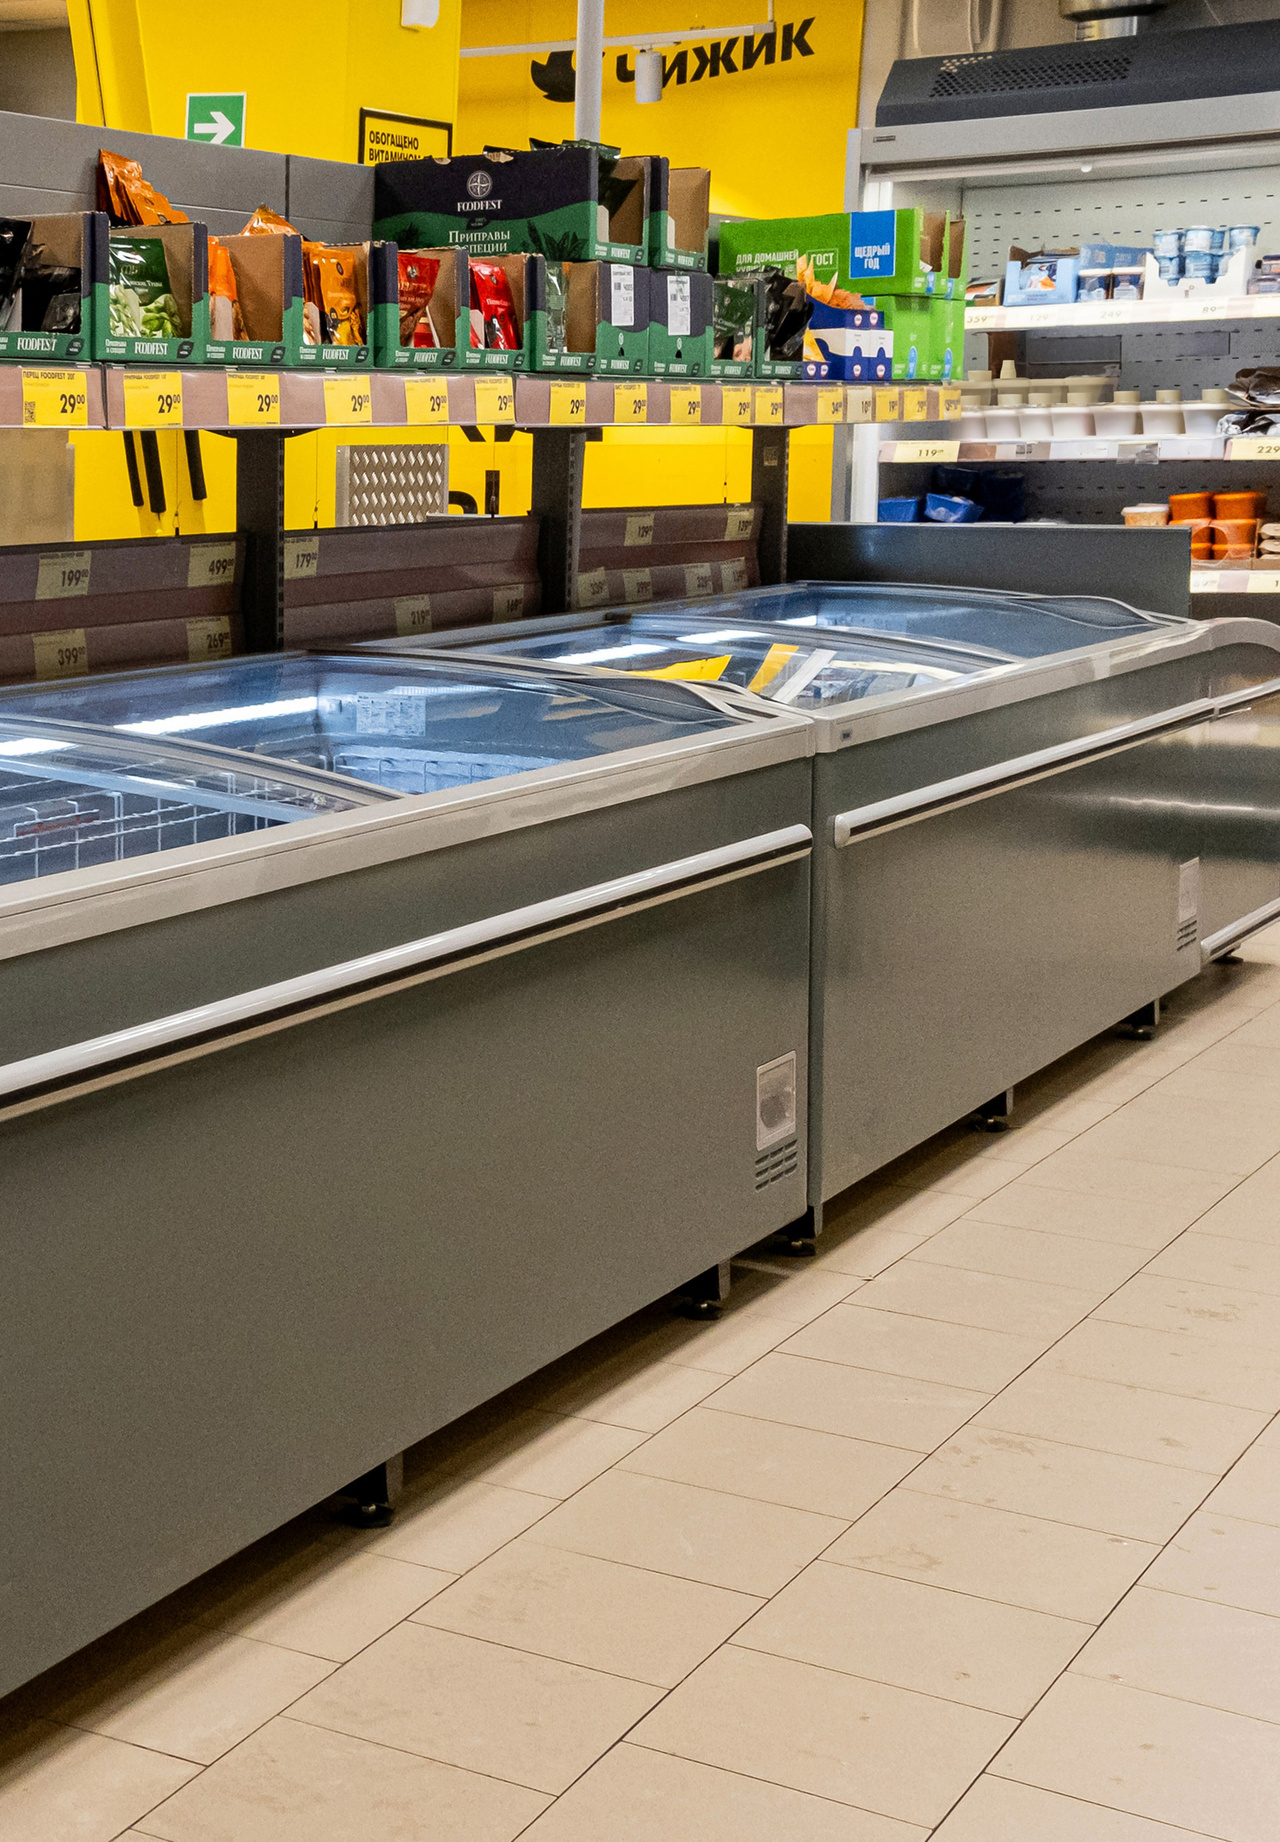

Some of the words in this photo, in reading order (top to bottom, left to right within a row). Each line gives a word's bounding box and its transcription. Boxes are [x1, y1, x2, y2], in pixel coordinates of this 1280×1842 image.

[369, 130, 419, 151] ОБОГАЩЕНО
[368, 148, 422, 162] ВИТАМИН
[457, 200, 502, 212] FOODFEST
[458, 242, 507, 255] ПЕЦИИ
[854, 243, 891, 258] ЩЕДРЫЙ
[735, 254, 753, 265] ДЛЯ
[810, 253, 835, 266] ГОСТ
[864, 258, 880, 270] ГОД
[17, 337, 57, 351] FOODFEST
[134, 342, 168, 355] FOODFEST
[232, 347, 263, 360] FOODFEST
